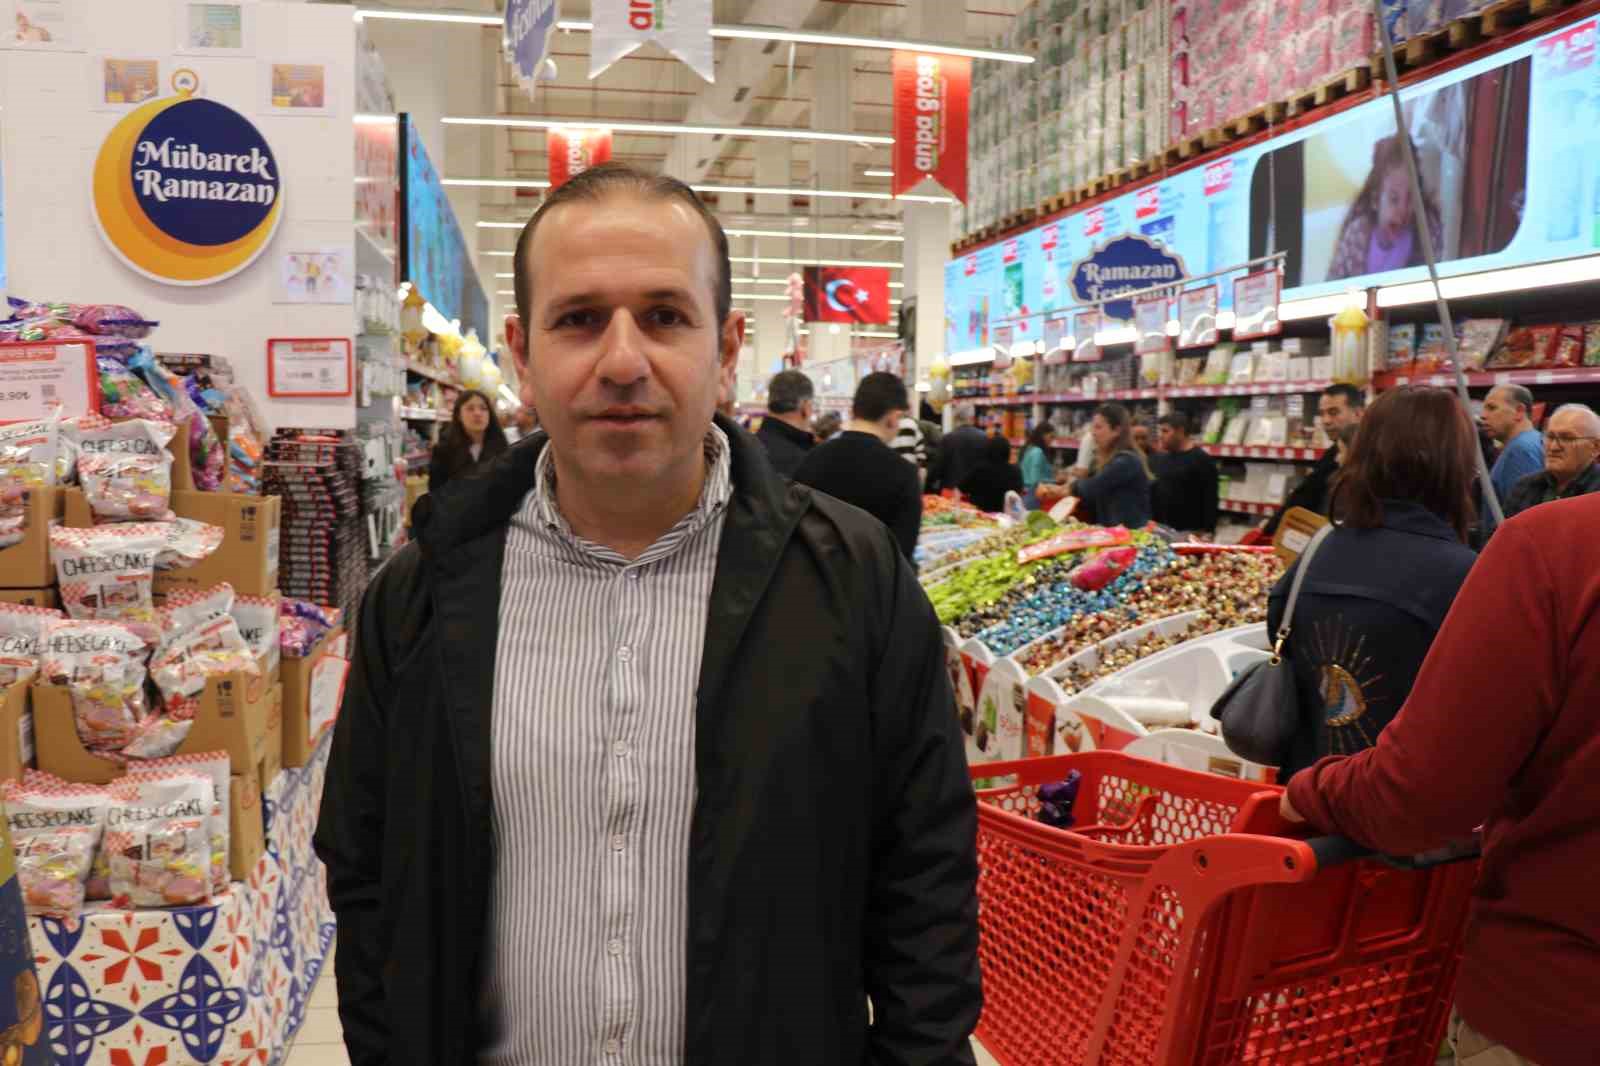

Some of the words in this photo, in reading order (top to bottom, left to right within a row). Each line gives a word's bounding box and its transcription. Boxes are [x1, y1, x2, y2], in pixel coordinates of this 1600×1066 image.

[135, 137, 276, 180] Mübarek
[914, 115, 938, 172] anpa
[134, 169, 275, 206] Ramazan
[1081, 262, 1176, 284] Ramazan
[62, 552, 152, 577] CHEESECAKE
